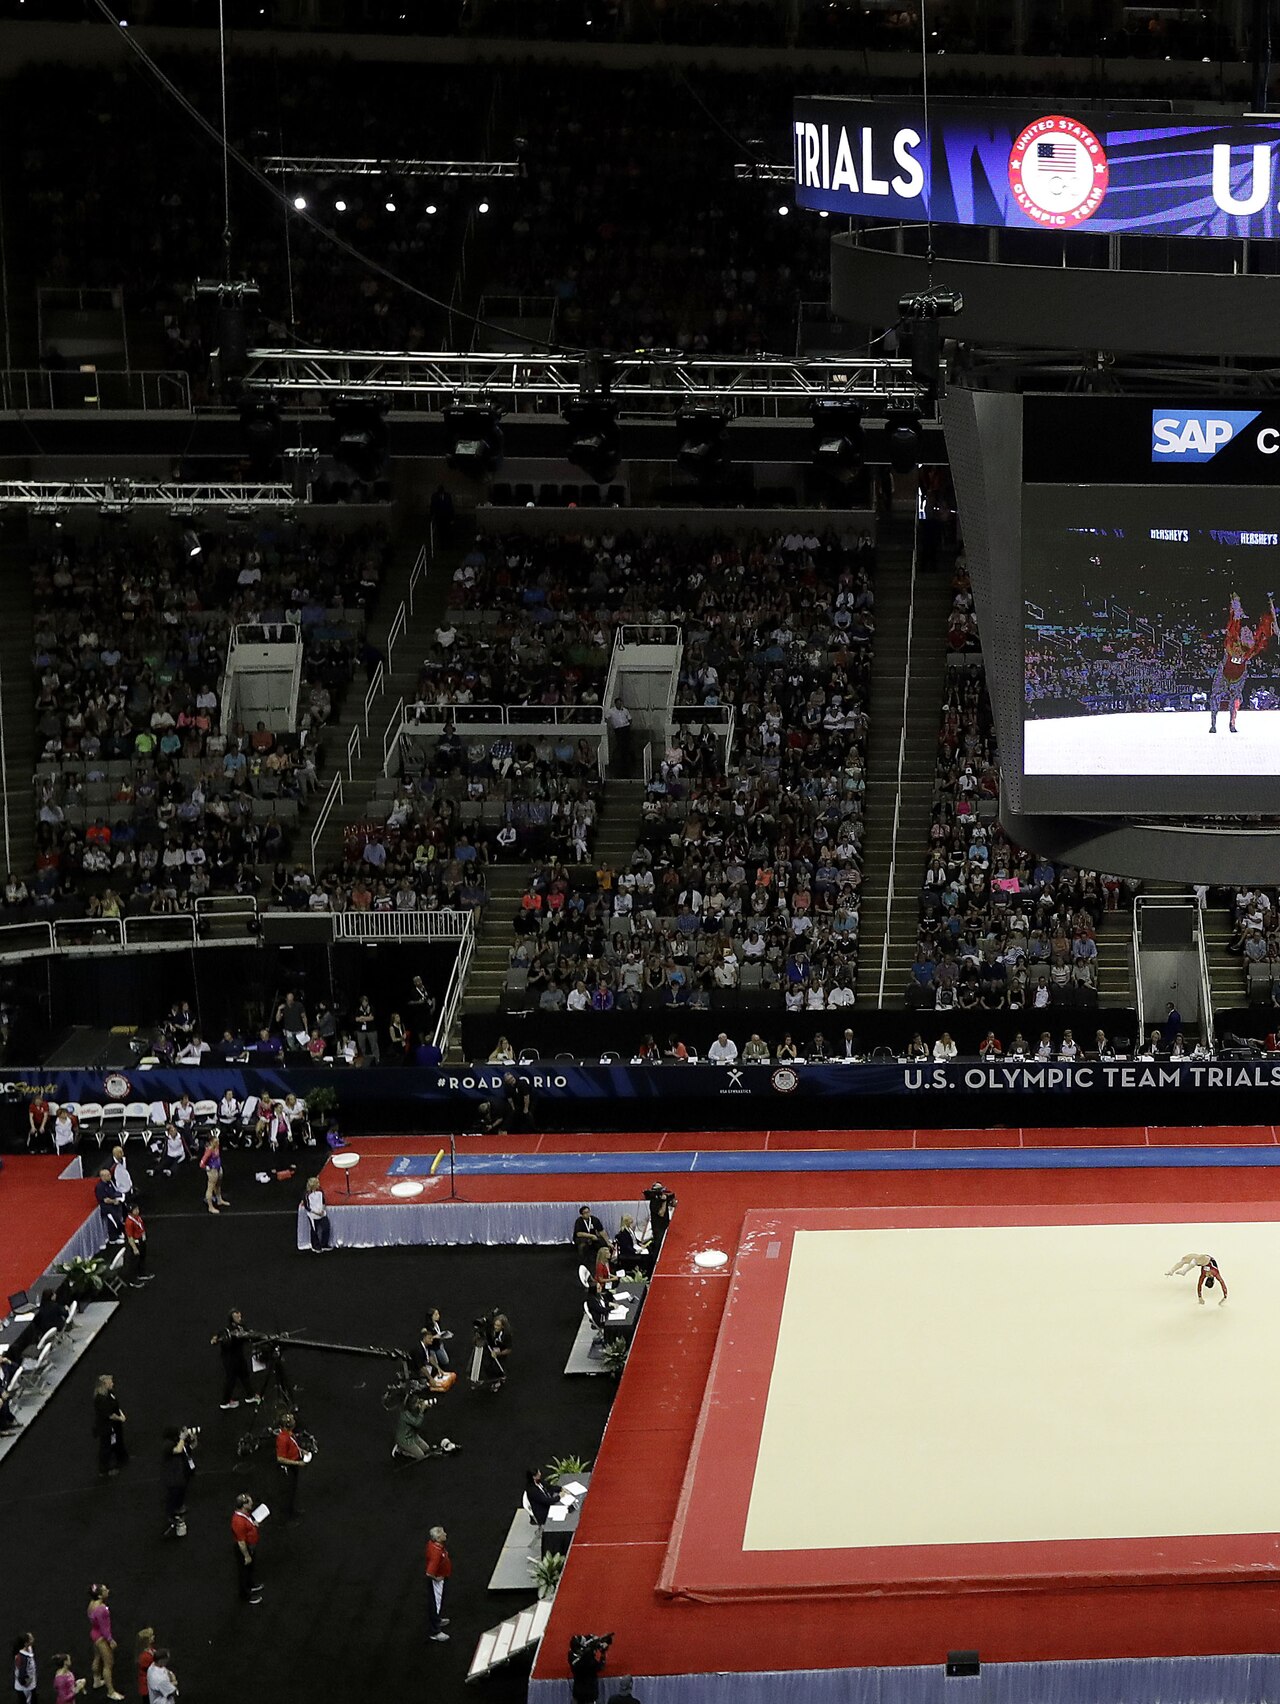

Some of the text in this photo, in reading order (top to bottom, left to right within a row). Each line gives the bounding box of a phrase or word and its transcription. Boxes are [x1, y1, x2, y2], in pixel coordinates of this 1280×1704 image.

[1016, 120, 1098, 153] UNITED STATES
[795, 122, 923, 198] TRIALS
[1014, 183, 1103, 225] OLYMPIC TEAM
[1154, 419, 1233, 454] SAP
[437, 1076, 567, 1089] #ROADRIO
[904, 1070, 955, 1089] U.S.
[965, 1068, 1093, 1089] OLYMPIC
[1103, 1068, 1180, 1088] TEAM
